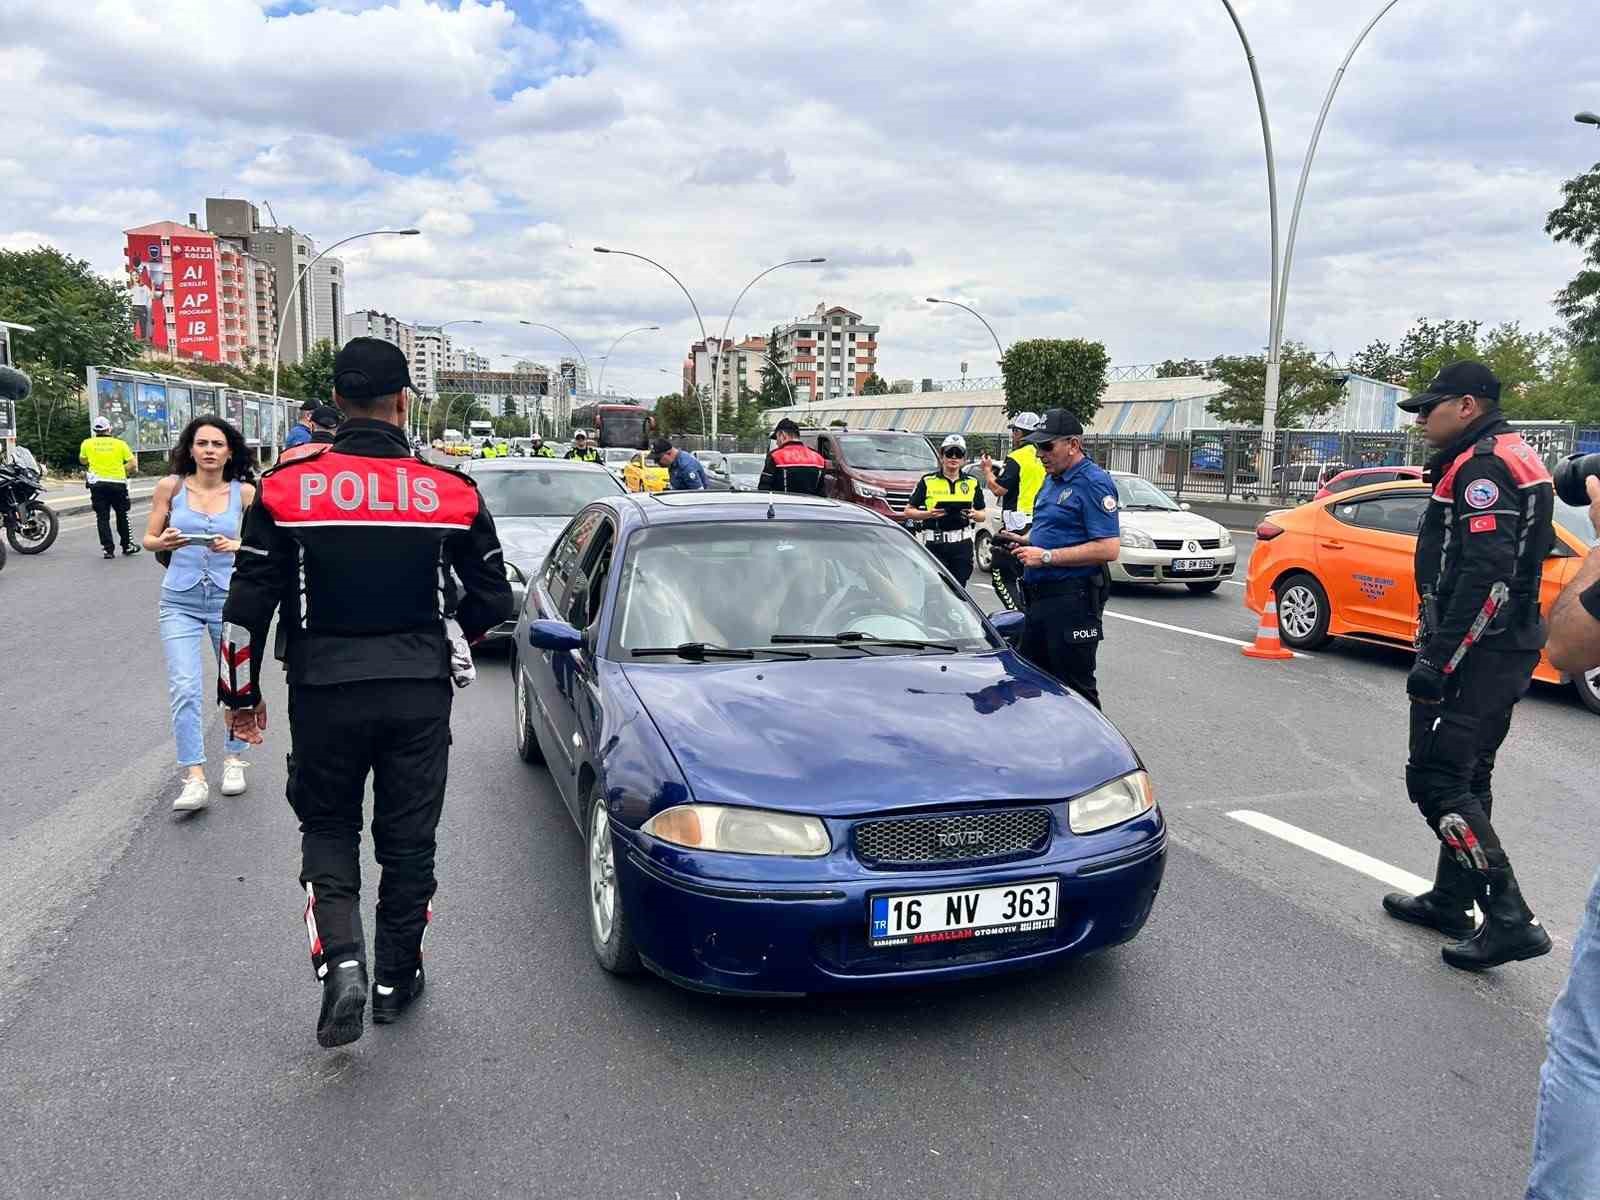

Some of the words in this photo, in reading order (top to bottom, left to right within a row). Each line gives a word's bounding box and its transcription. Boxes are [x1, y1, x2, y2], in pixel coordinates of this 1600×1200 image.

[182, 293, 209, 308] AP
[188, 320, 206, 336] IB
[300, 467, 440, 512] POLİS
[936, 830, 987, 848] ROVER
[893, 899, 922, 931] 16
[945, 893, 980, 927] NV
[1002, 886, 1051, 920] 363
[873, 919, 887, 930] TR
